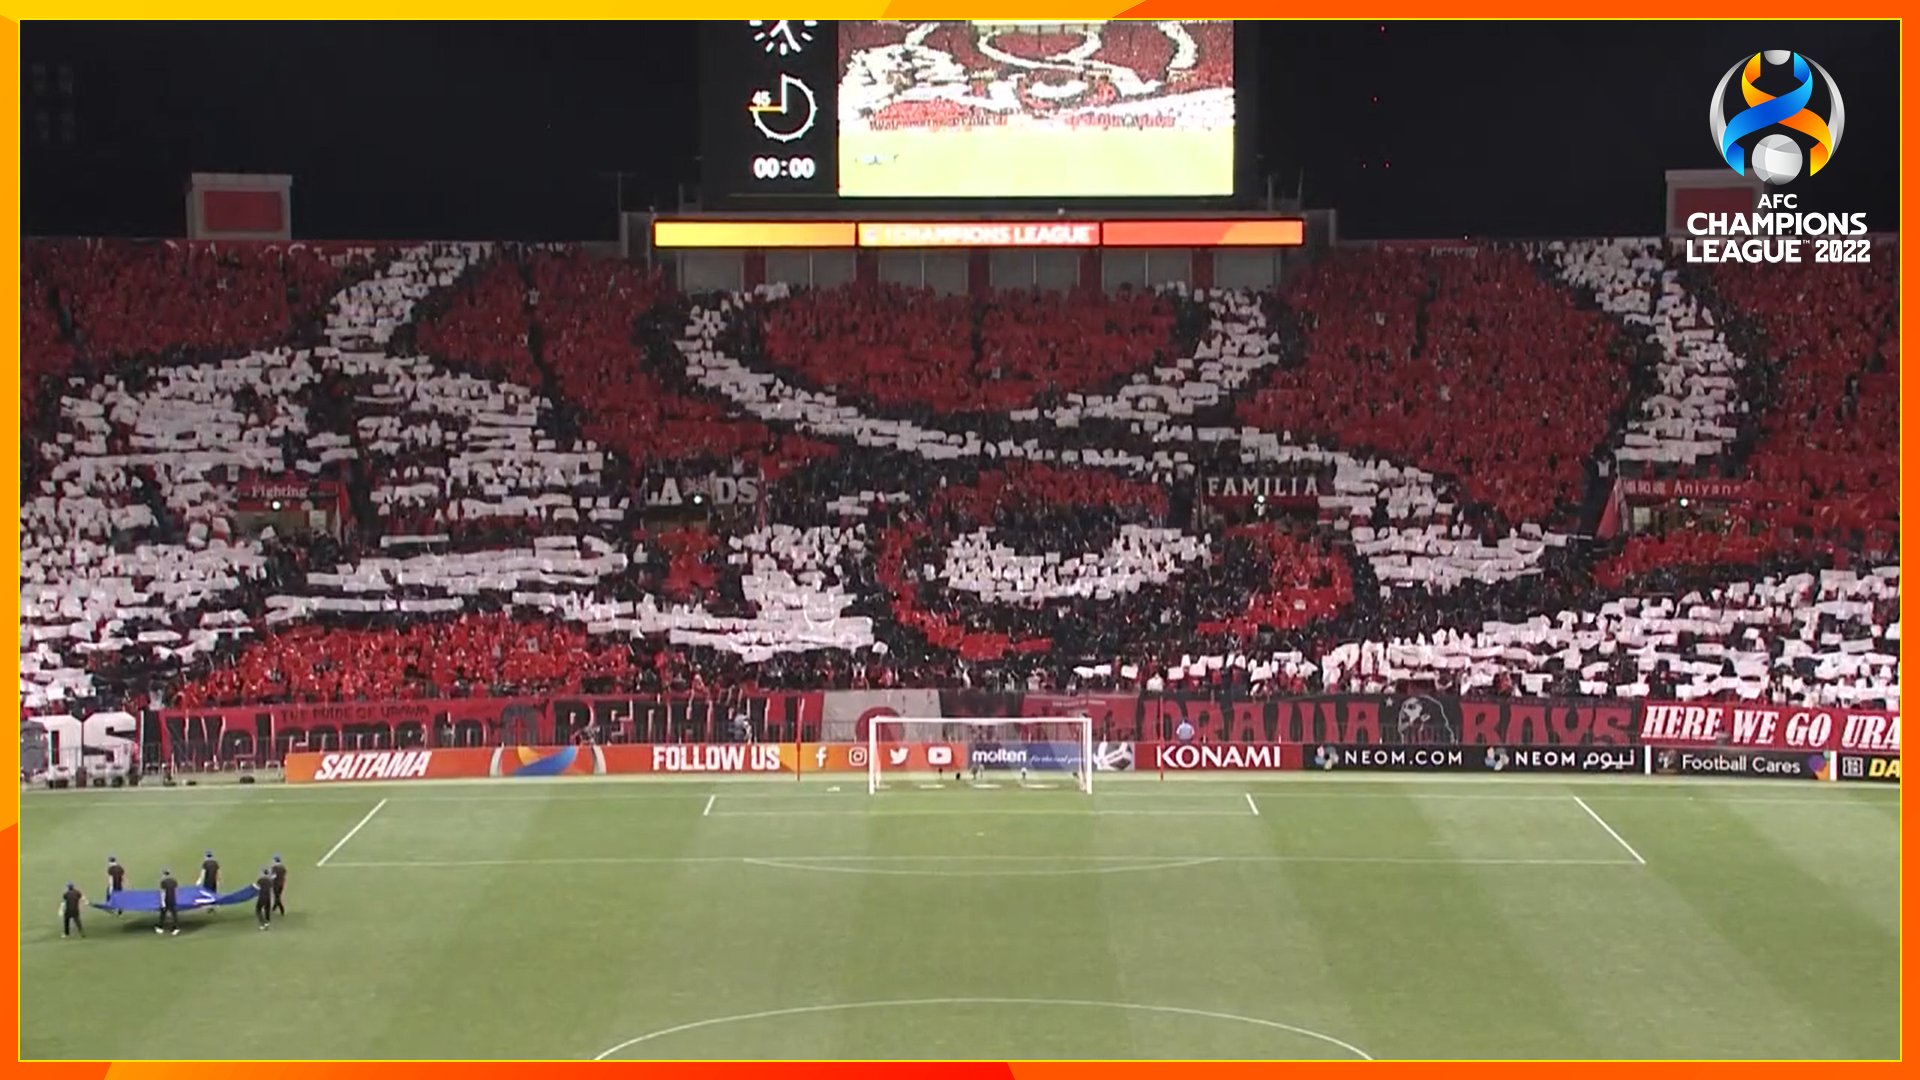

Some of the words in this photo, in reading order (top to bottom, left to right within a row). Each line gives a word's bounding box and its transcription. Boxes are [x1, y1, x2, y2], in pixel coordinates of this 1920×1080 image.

[752, 91, 771, 106] 45
[754, 157, 815, 178] 00:00
[251, 484, 309, 499] Fighting
[1207, 476, 1319, 497] FAMILIA
[1641, 705, 1724, 740] HERE
[1733, 709, 1779, 744] WE
[1785, 712, 1832, 747] GO
[314, 752, 432, 769] SAITAMA
[653, 746, 744, 770] FOLLOW
[750, 745, 780, 770] US
[972, 748, 1026, 764] molten
[1157, 746, 1281, 768] KONAMI
[1344, 750, 1462, 765] NEOM.COM
[1515, 752, 1576, 766] NEOM
[1682, 753, 1747, 772] Football
[1752, 756, 1801, 774] Cares
